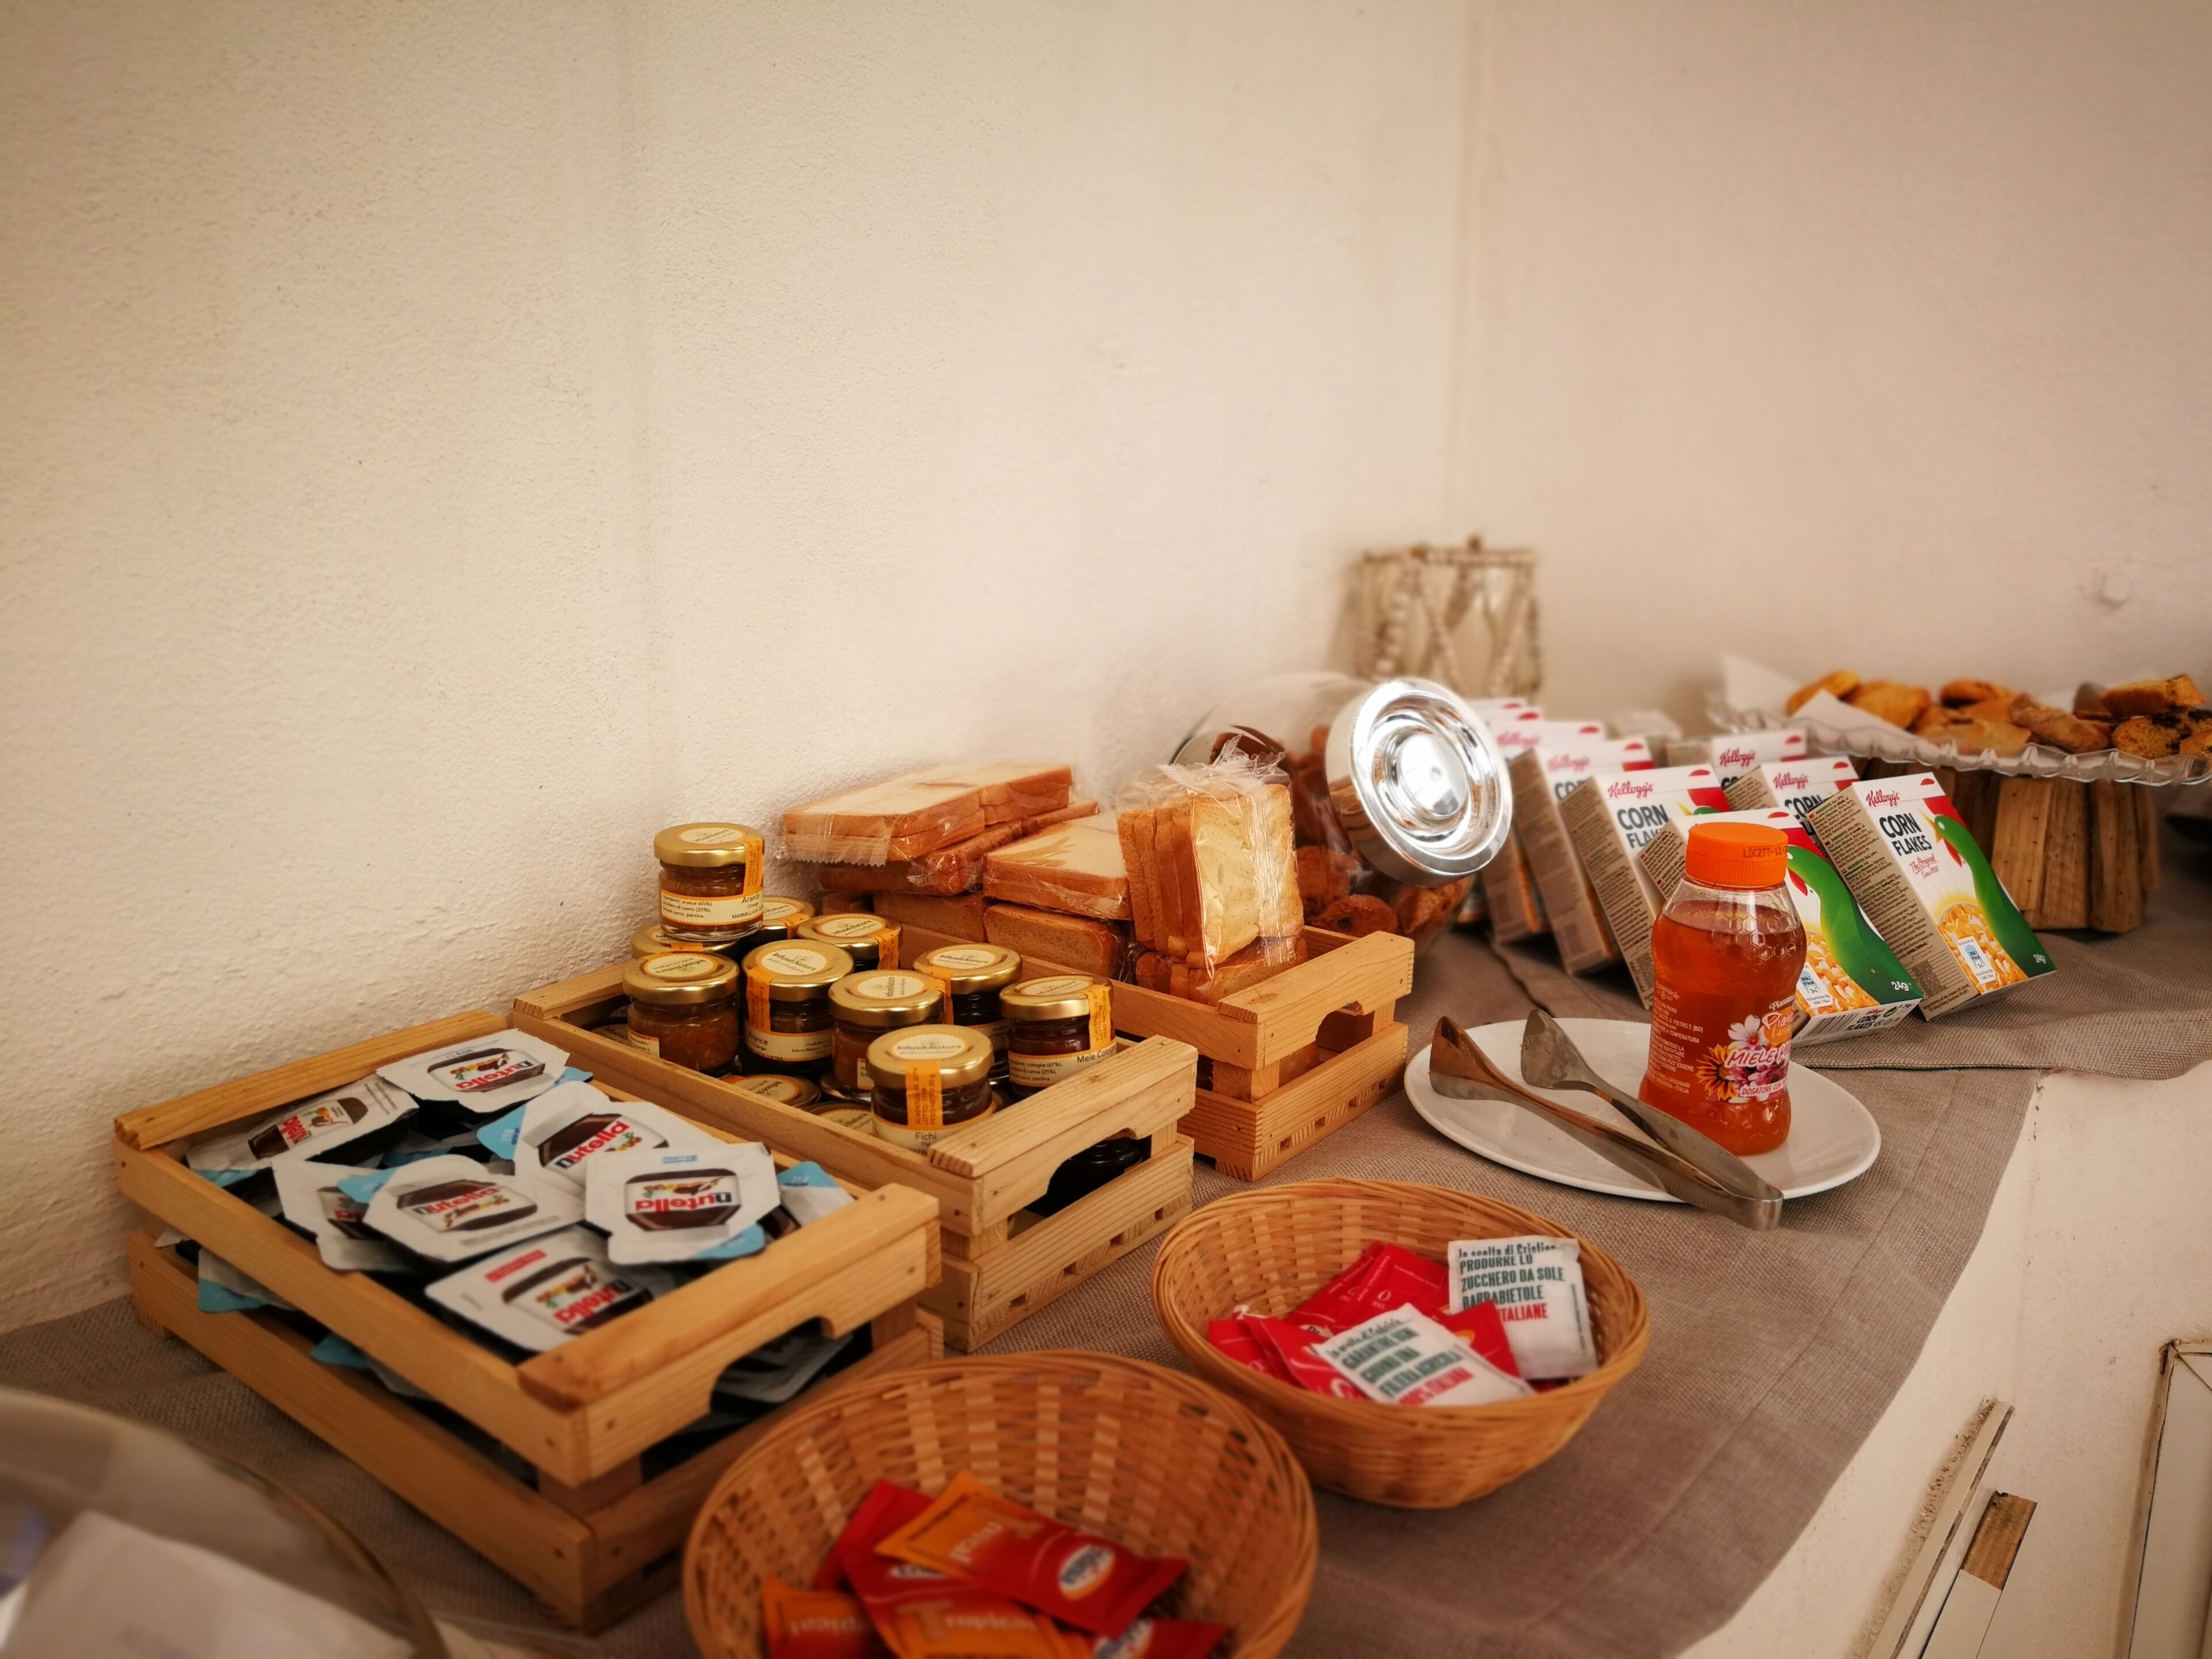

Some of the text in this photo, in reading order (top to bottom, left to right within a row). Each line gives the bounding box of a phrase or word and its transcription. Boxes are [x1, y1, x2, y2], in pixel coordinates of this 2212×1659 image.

[1719, 748, 1756, 767] Kellogg's
[1773, 772, 1809, 789] Kellogg's
[1607, 781, 1654, 798] Kellogg's
[1866, 789, 1900, 806] Kellogg's
[1879, 812, 1922, 838] CORN
[1892, 835, 1932, 856] FLAKES
[742, 893, 760, 904] Arance
[732, 908, 758, 919] MARMELLATA
[1673, 1019, 1688, 1029] PIETRO
[1692, 1025, 1703, 1033] (BO)
[1669, 1029, 1700, 1043] TEMPERATURA
[1077, 1054, 1096, 1064] Mele
[1726, 1048, 1777, 1067] MIELE
[455, 1060, 534, 1089] nutella
[1676, 1062, 1694, 1071] ESSERE
[1668, 1077, 1690, 1088] ORIGINARI
[1675, 1085, 1689, 1094] ITALIA
[1742, 1085, 1772, 1095] DOSATORE
[554, 1120, 630, 1169] nutella
[915, 1131, 937, 1141] Fichi
[411, 1187, 501, 1215] nutella
[635, 1192, 732, 1214] nutella
[1505, 1244, 1514, 1256] di
[1460, 1254, 1533, 1275] PRODURRE LO
[1461, 1267, 1565, 1293] ZUCCHERO DA SOLE
[553, 1278, 633, 1325] nutella
[1379, 1369, 1421, 1398] FILIERA
